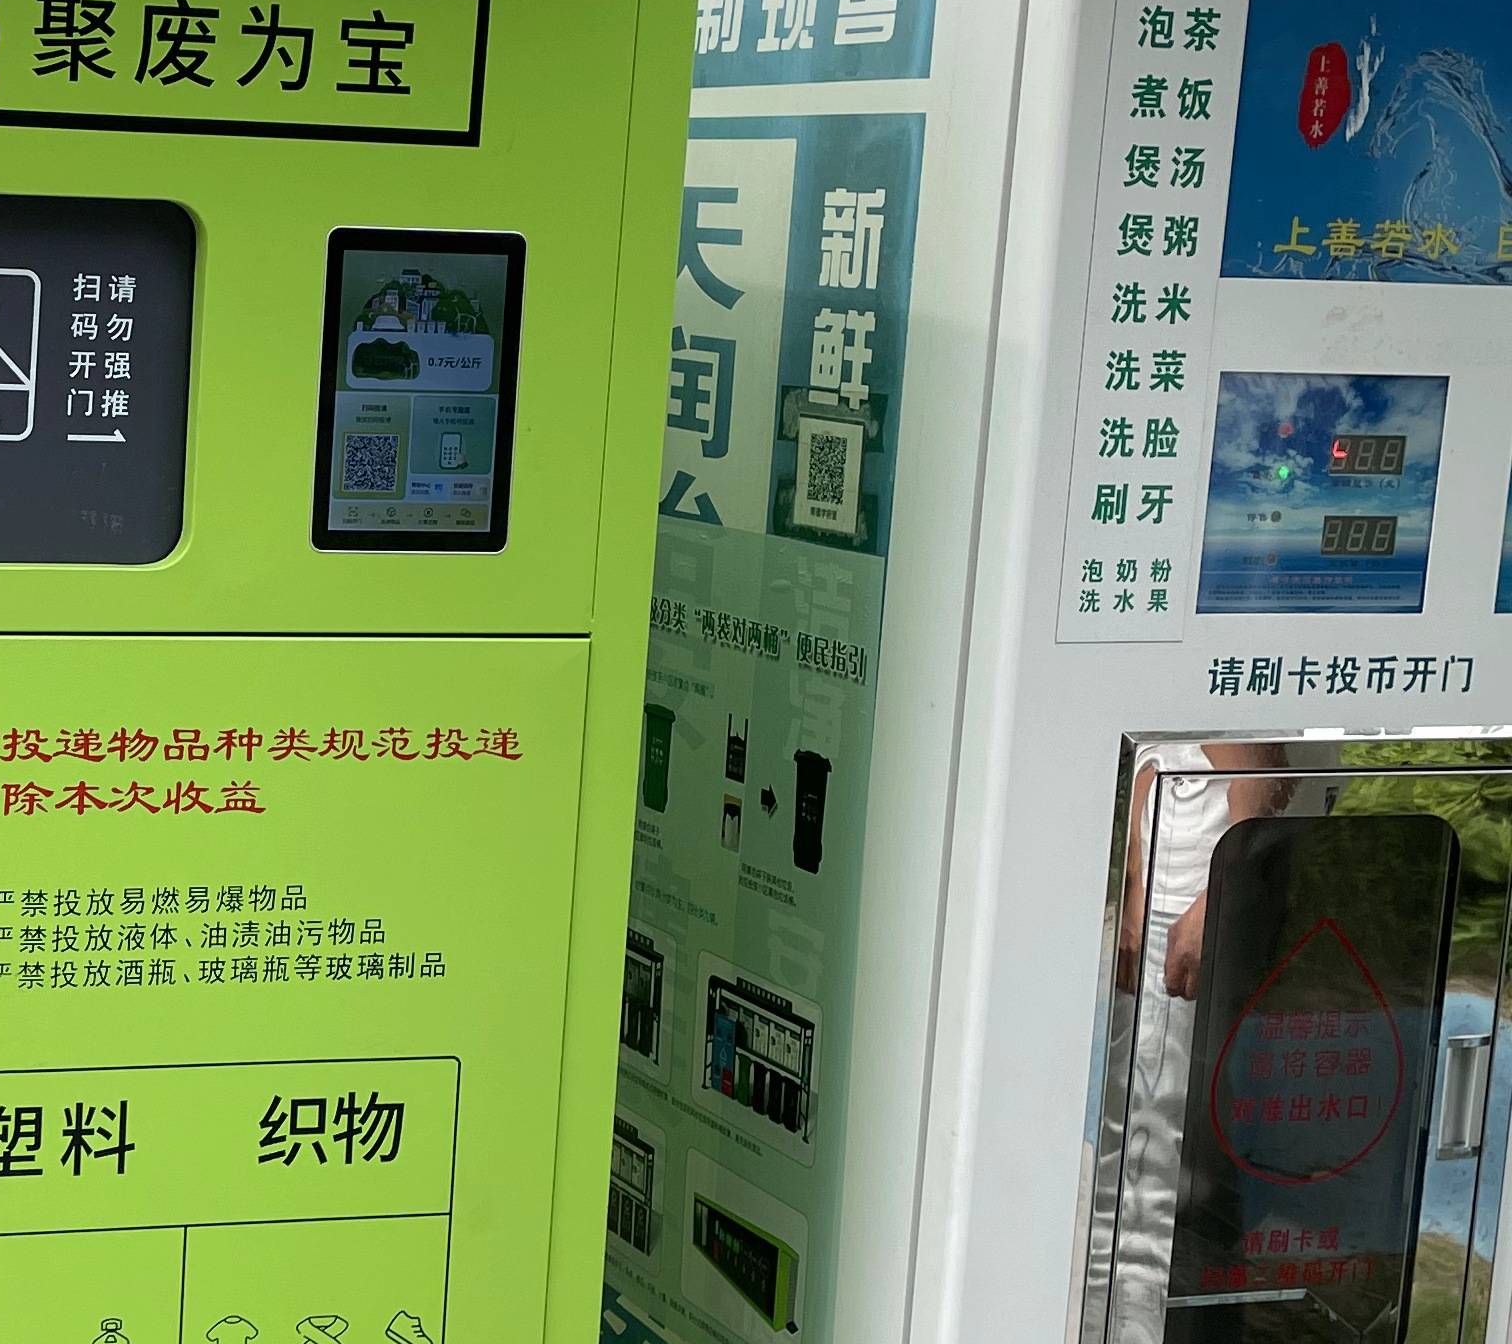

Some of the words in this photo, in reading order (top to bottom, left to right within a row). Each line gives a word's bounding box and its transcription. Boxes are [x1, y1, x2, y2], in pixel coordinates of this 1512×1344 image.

[1137, 4, 1222, 52] 泡茶
[1129, 74, 1214, 121] 煮饭
[1123, 143, 1206, 190] 煲汤
[1116, 212, 1200, 258] 煲粥
[1273, 215, 1463, 260] 上善若水
[809, 187, 887, 410] 新鲜
[1110, 282, 1193, 325] 洗米
[65, 272, 102, 420] 扫码开门
[99, 272, 138, 419] 请勿强推
[427, 356, 482, 370] 0.7元/公斤
[1105, 349, 1186, 393] 洗菜
[1098, 416, 1181, 459] 洗脸
[1090, 483, 1173, 524] 刷牙
[1081, 557, 1172, 584] 泡奶粉
[1078, 588, 1169, 614] 洗水果
[797, 631, 865, 680] 便民指引
[1207, 654, 1475, 697] 请刷卡投币开门
[256, 1091, 406, 1167] 织物
